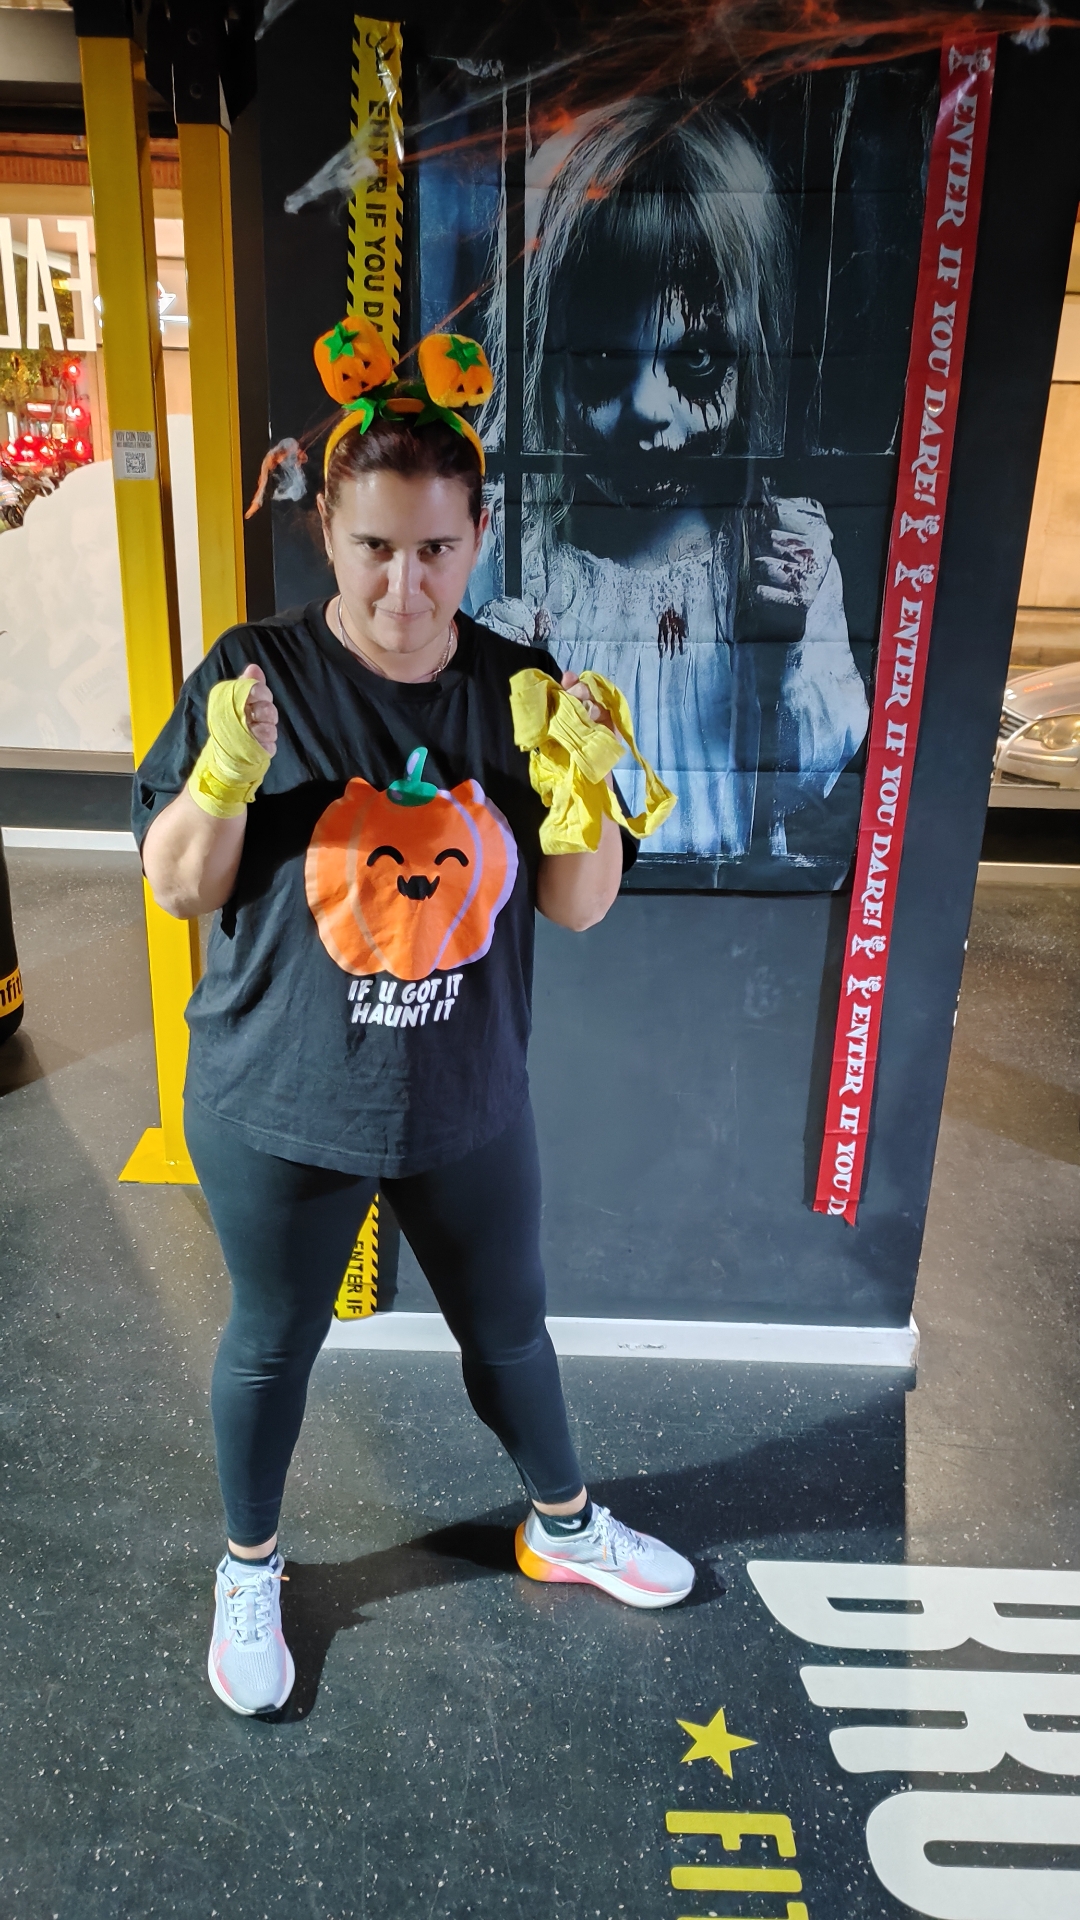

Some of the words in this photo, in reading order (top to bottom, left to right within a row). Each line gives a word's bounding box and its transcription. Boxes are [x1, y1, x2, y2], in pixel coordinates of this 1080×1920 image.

[366, 101, 390, 194] ENTER
[937, 88, 978, 230] ENTER
[365, 203, 387, 228] IF
[364, 236, 386, 292] YOU
[937, 243, 963, 290] IF
[928, 300, 956, 378] YOU
[911, 384, 947, 506] DARE!
[885, 597, 923, 711] ENTER
[885, 719, 908, 757] IF
[876, 765, 903, 827] YOU
[861, 832, 893, 929] DARE!
[347, 979, 374, 1001] IF
[378, 980, 398, 1004] U
[401, 979, 443, 1004] GOT
[445, 973, 464, 998] IT
[351, 1002, 431, 1028] HAUNT
[433, 998, 456, 1022] IT
[838, 1002, 872, 1097] ENTER
[840, 1103, 861, 1135] IF
[832, 1141, 857, 1192] YOU
[827, 1195, 849, 1216] D
[346, 1299, 363, 1315] IF
